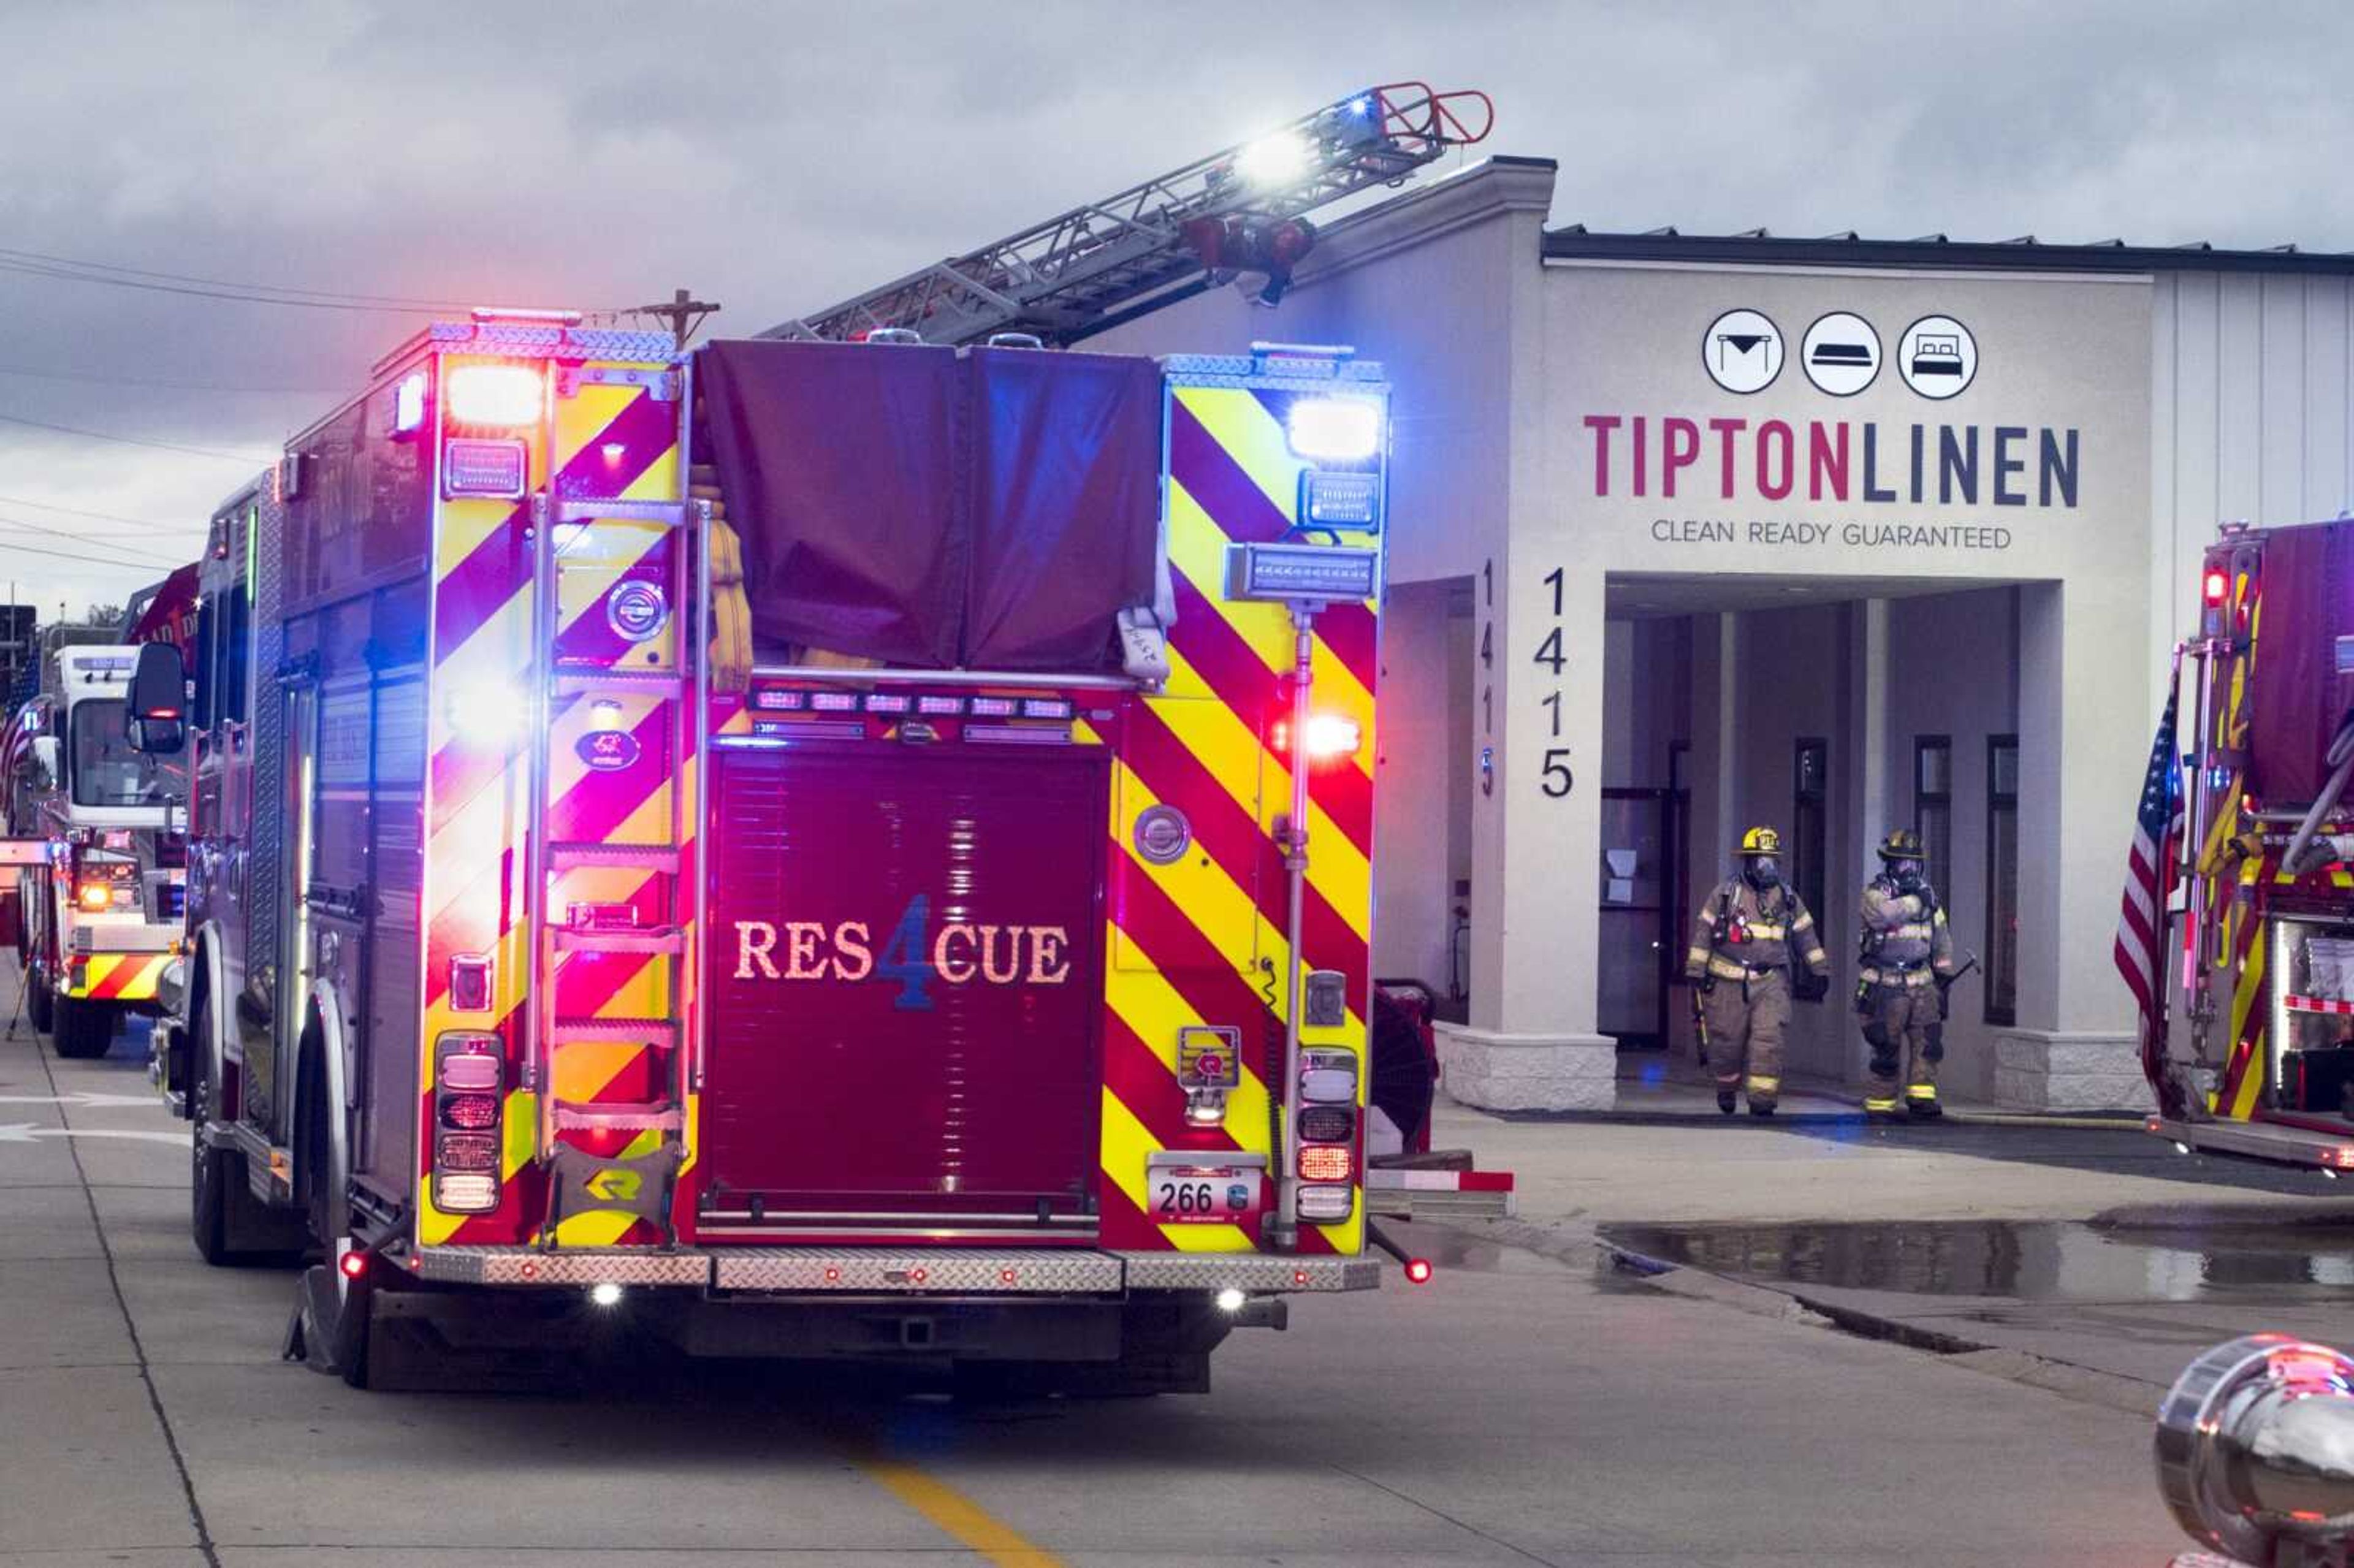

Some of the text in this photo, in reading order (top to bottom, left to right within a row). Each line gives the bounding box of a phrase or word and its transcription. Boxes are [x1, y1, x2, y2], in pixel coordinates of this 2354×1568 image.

[1651, 519, 2012, 549] CLEAN READY GUARANTEED
[1159, 1182, 1213, 1214] 266
